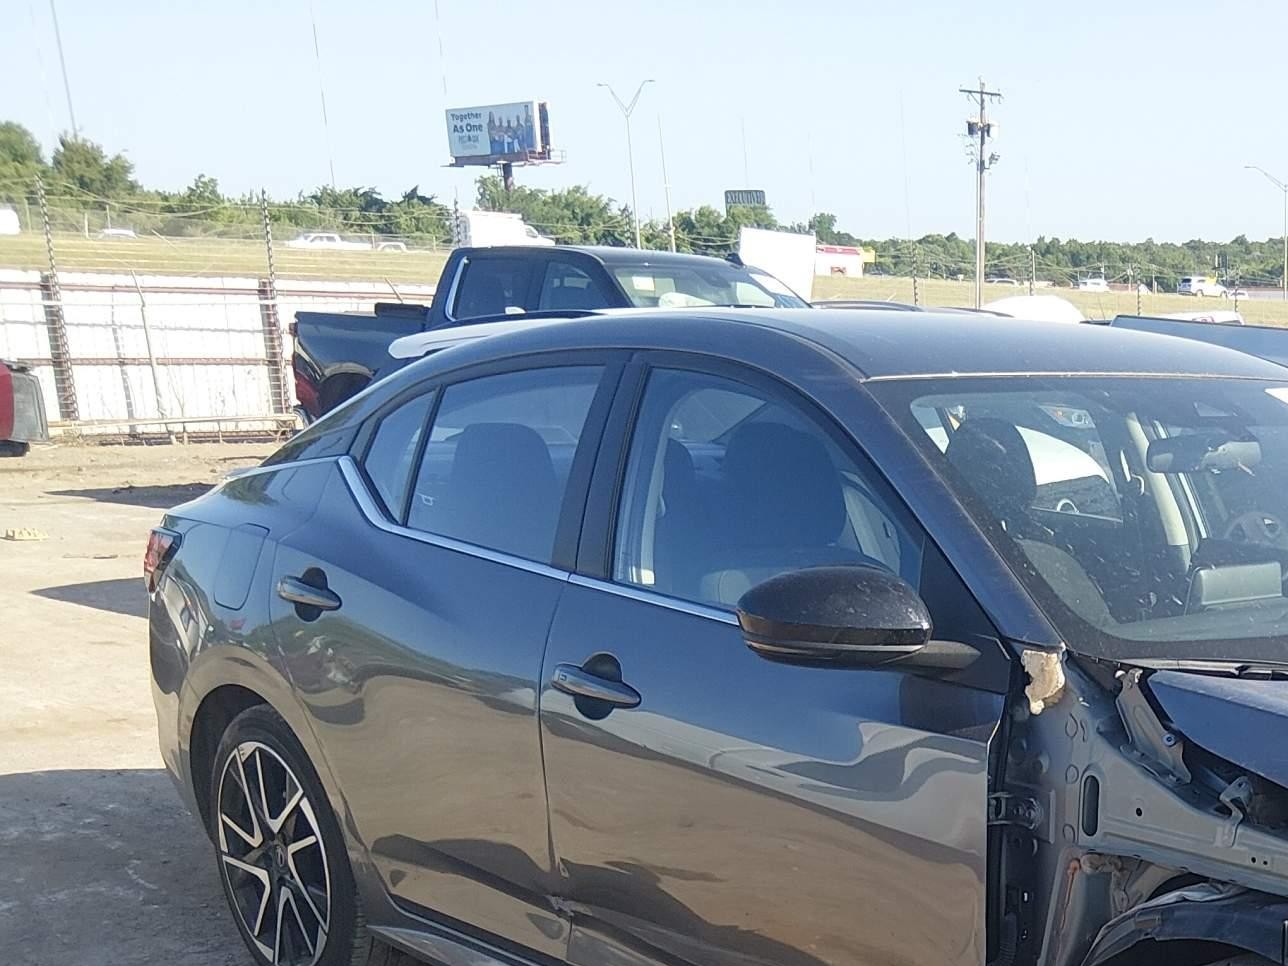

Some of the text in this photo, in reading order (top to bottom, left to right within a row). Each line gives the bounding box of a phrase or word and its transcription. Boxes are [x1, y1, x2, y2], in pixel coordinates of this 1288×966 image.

[450, 112, 482, 122] Together
[453, 122, 483, 133] As One
